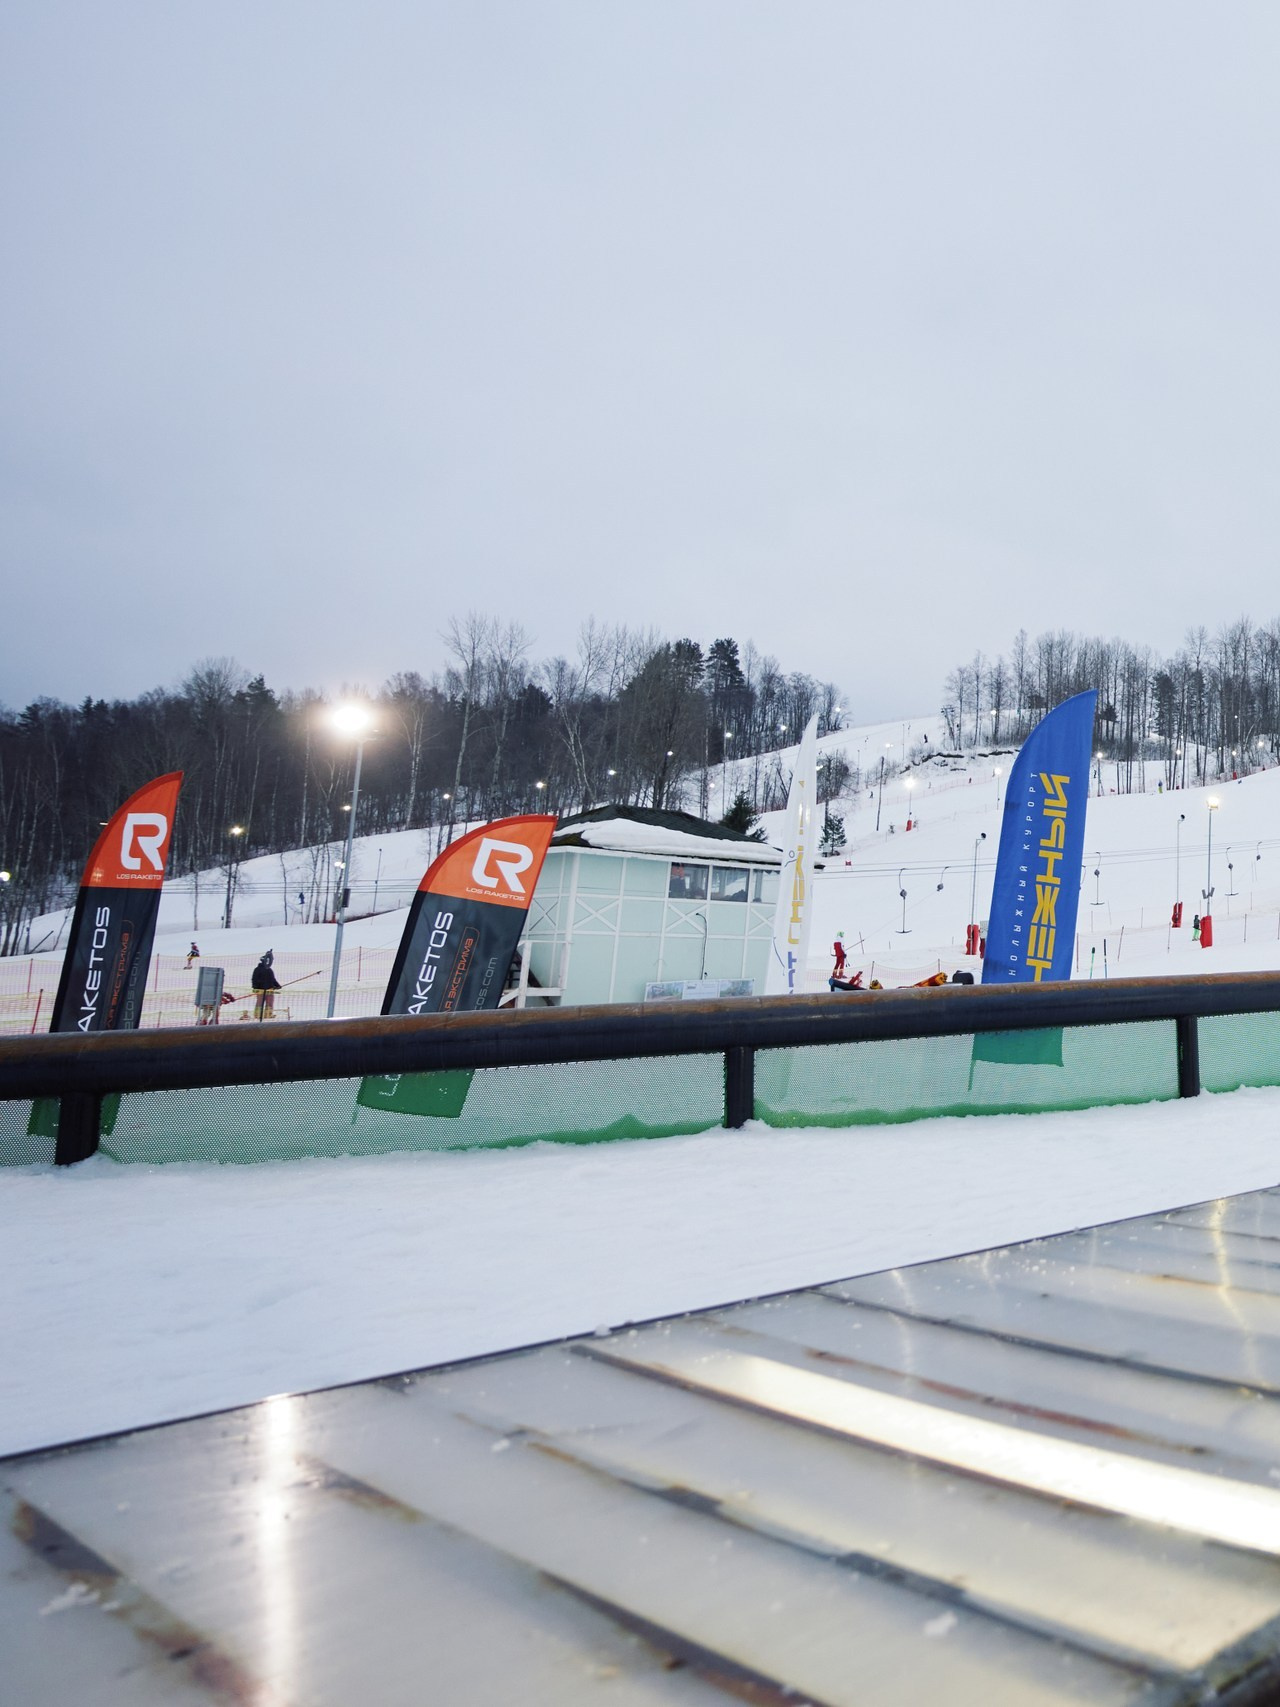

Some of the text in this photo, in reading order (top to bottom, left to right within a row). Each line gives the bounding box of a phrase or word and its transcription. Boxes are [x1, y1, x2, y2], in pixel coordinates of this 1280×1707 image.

[466, 887, 525, 901] LOS RAKETOS
[1008, 772, 1037, 976] НОЛЫЖНЫЙ КУРОРТ
[1026, 772, 1070, 981] НЕЖНЫЙ
[78, 907, 110, 1032] AKETOS
[408, 911, 454, 1014] AKETOS
